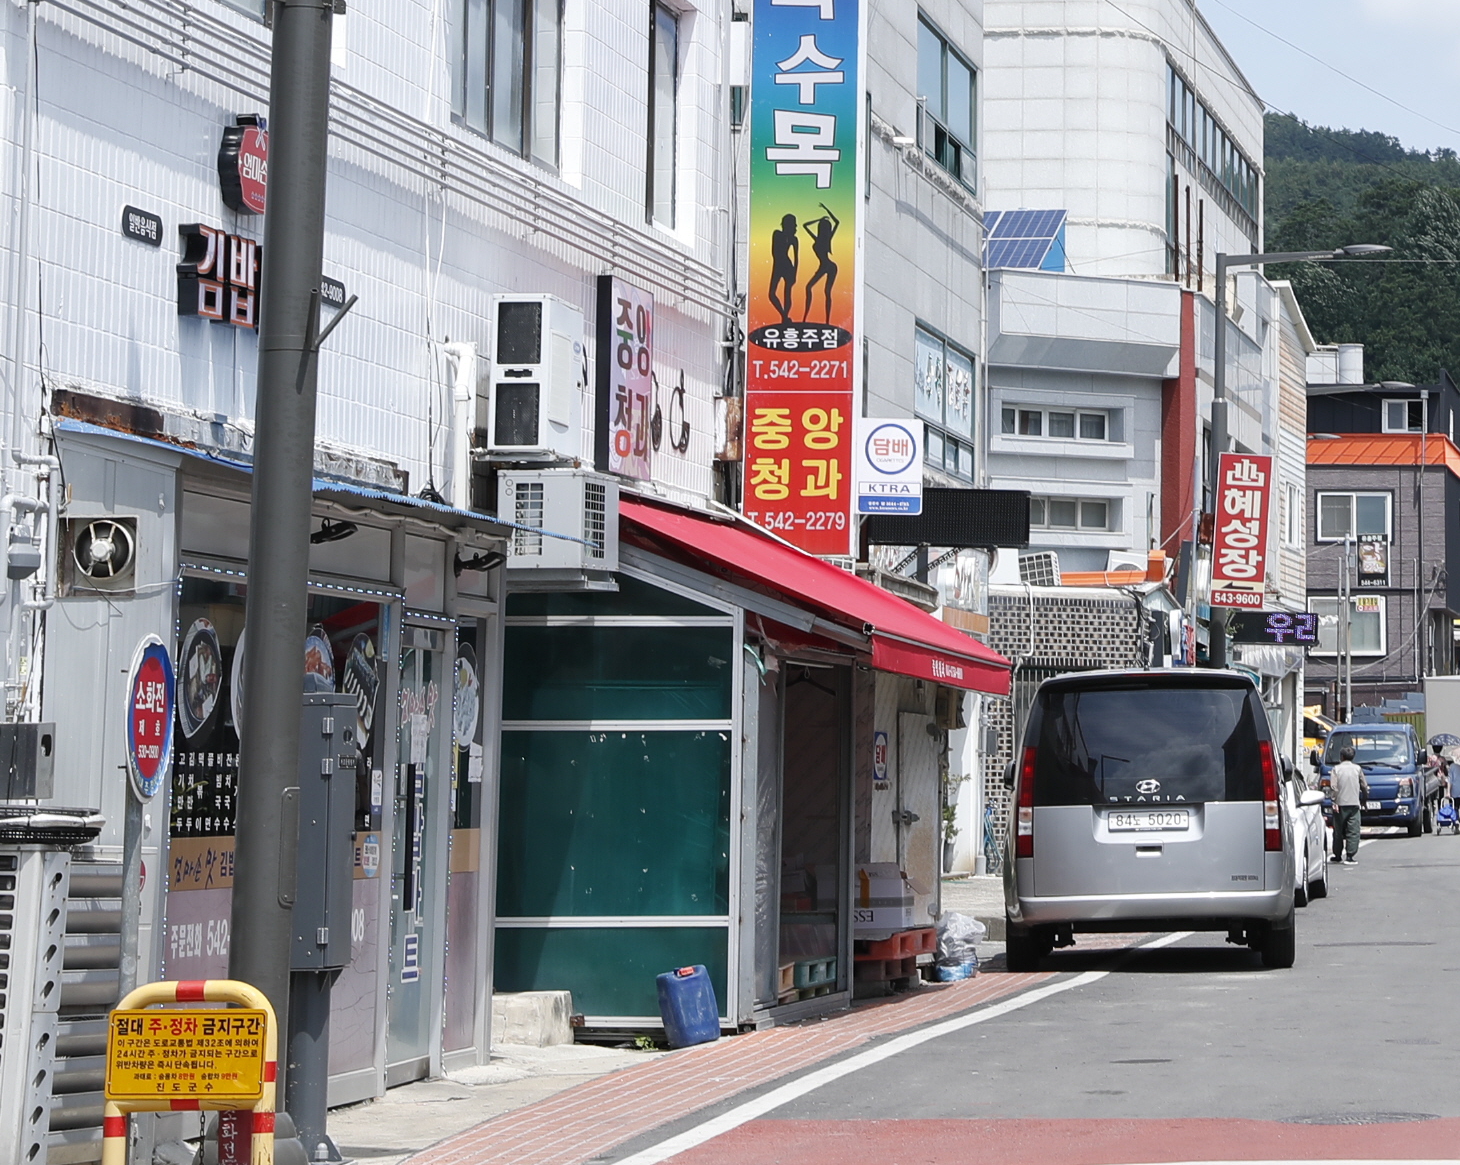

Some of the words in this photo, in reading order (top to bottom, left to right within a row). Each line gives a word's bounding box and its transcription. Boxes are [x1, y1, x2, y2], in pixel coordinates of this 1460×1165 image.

[616, 297, 651, 378] 중앙
[762, 327, 839, 350] 유흥주점
[752, 359, 849, 380] T.542-2271
[613, 384, 651, 463] 청과
[751, 406, 845, 451] 중앙
[872, 437, 910, 458] 담배
[749, 456, 844, 502] 청과
[868, 483, 911, 494] KTRA
[1218, 487, 1264, 579] 혜성장
[135, 681, 166, 713] 소화전
[138, 719, 145, 737] 제
[154, 719, 162, 737] 호
[137, 744, 160, 759] 530-0900
[1109, 793, 1187, 803] STARIA
[1147, 812, 1182, 827] 5020
[206, 918, 231, 957] 542-
[115, 1017, 145, 1037] 절대
[201, 1017, 261, 1037] 금지구간
[117, 1038, 126, 1048] 이
[126, 1038, 152, 1048] 구간은
[152, 1038, 195, 1048] 도로교통법
[196, 1038, 234, 1048] 제32조에
[234, 1038, 260, 1048] 의하여
[116, 1049, 146, 1059] 24시간
[189, 1049, 223, 1059] 금지되는
[224, 1049, 259, 1059] 구간으로
[115, 1060, 155, 1071] 위반차량은
[156, 1060, 174, 1070] 즉시
